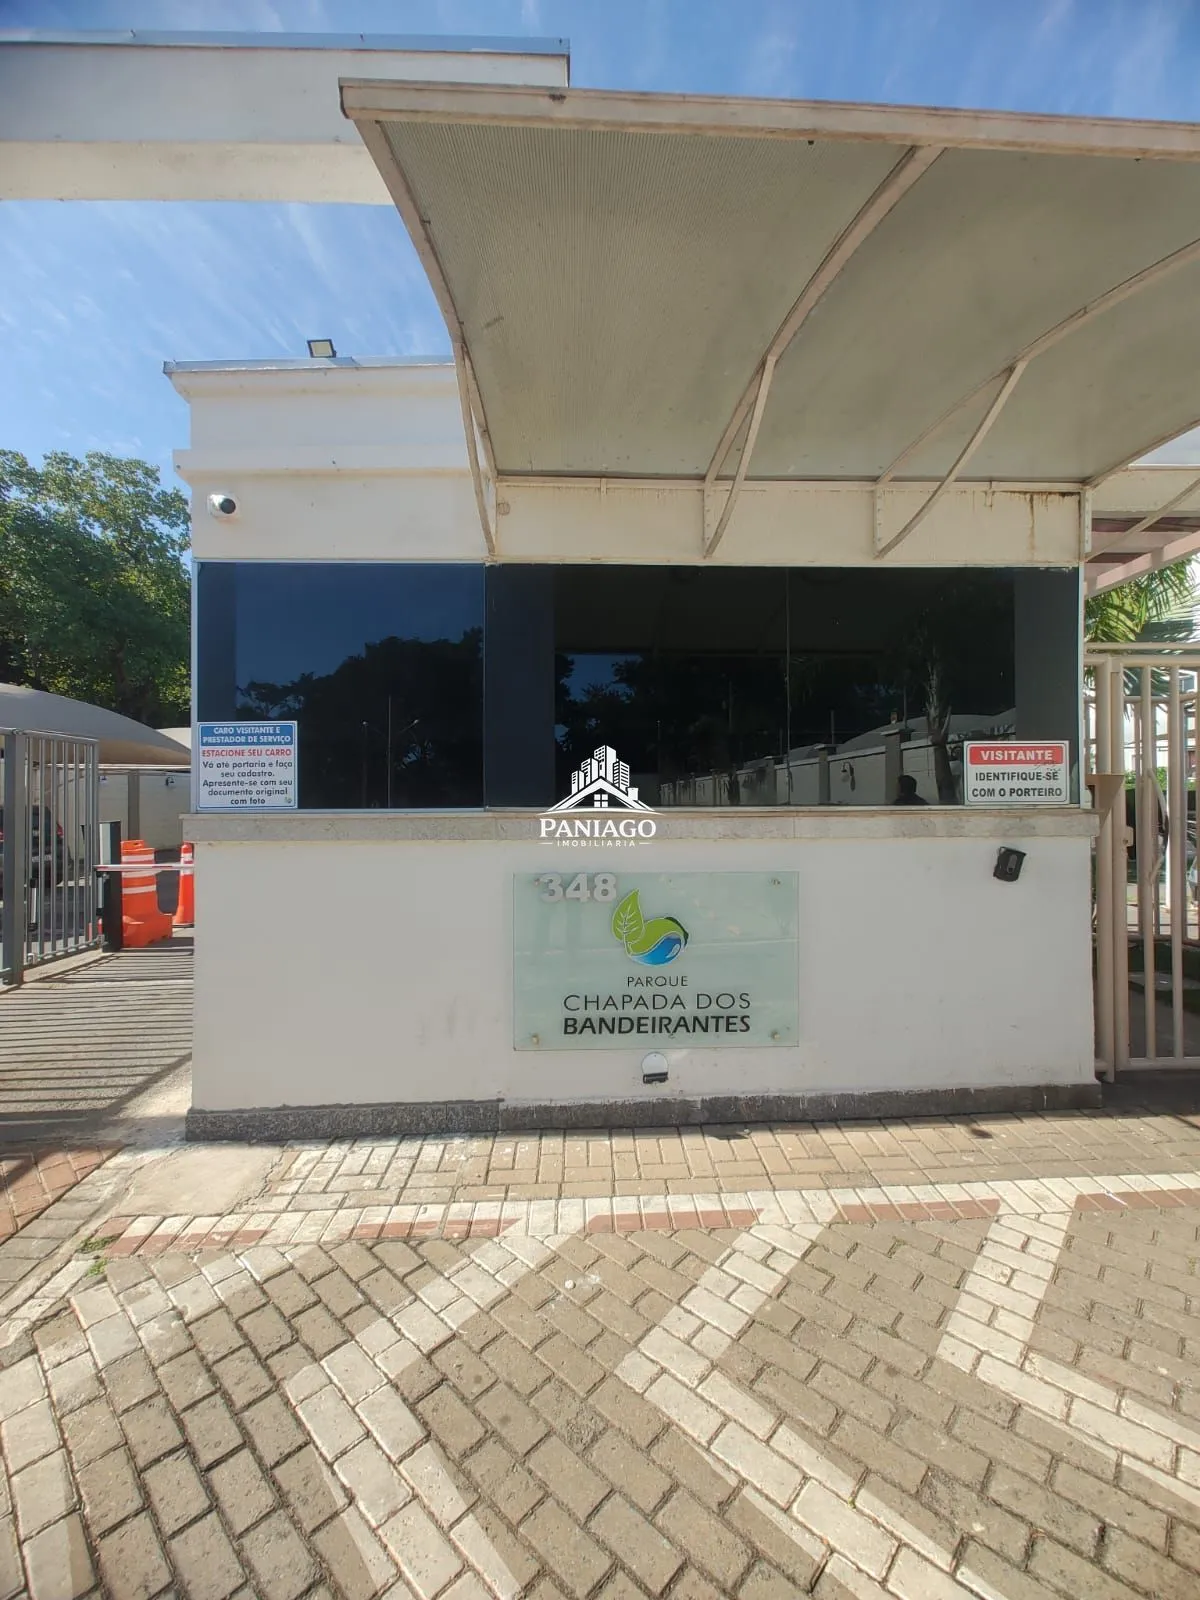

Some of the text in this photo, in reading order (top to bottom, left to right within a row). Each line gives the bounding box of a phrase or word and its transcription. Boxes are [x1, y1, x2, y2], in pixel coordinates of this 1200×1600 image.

[259, 736, 291, 744] SERVIÇO
[202, 749, 246, 757] ESTACIONE
[980, 750, 1053, 760] VISITANTE
[232, 761, 266, 769] portaria
[275, 760, 293, 769] faça
[975, 772, 1059, 781] IDENTIFIQUE-SE
[202, 780, 258, 788] Apresente-se
[256, 788, 288, 796] original
[972, 788, 1062, 797] COM O PORTEIRO
[540, 873, 617, 902] 348
[627, 976, 688, 988] PARQUE
[563, 993, 751, 1012] CHAPADA DOS
[563, 1015, 750, 1035] BANDEIRANTES
